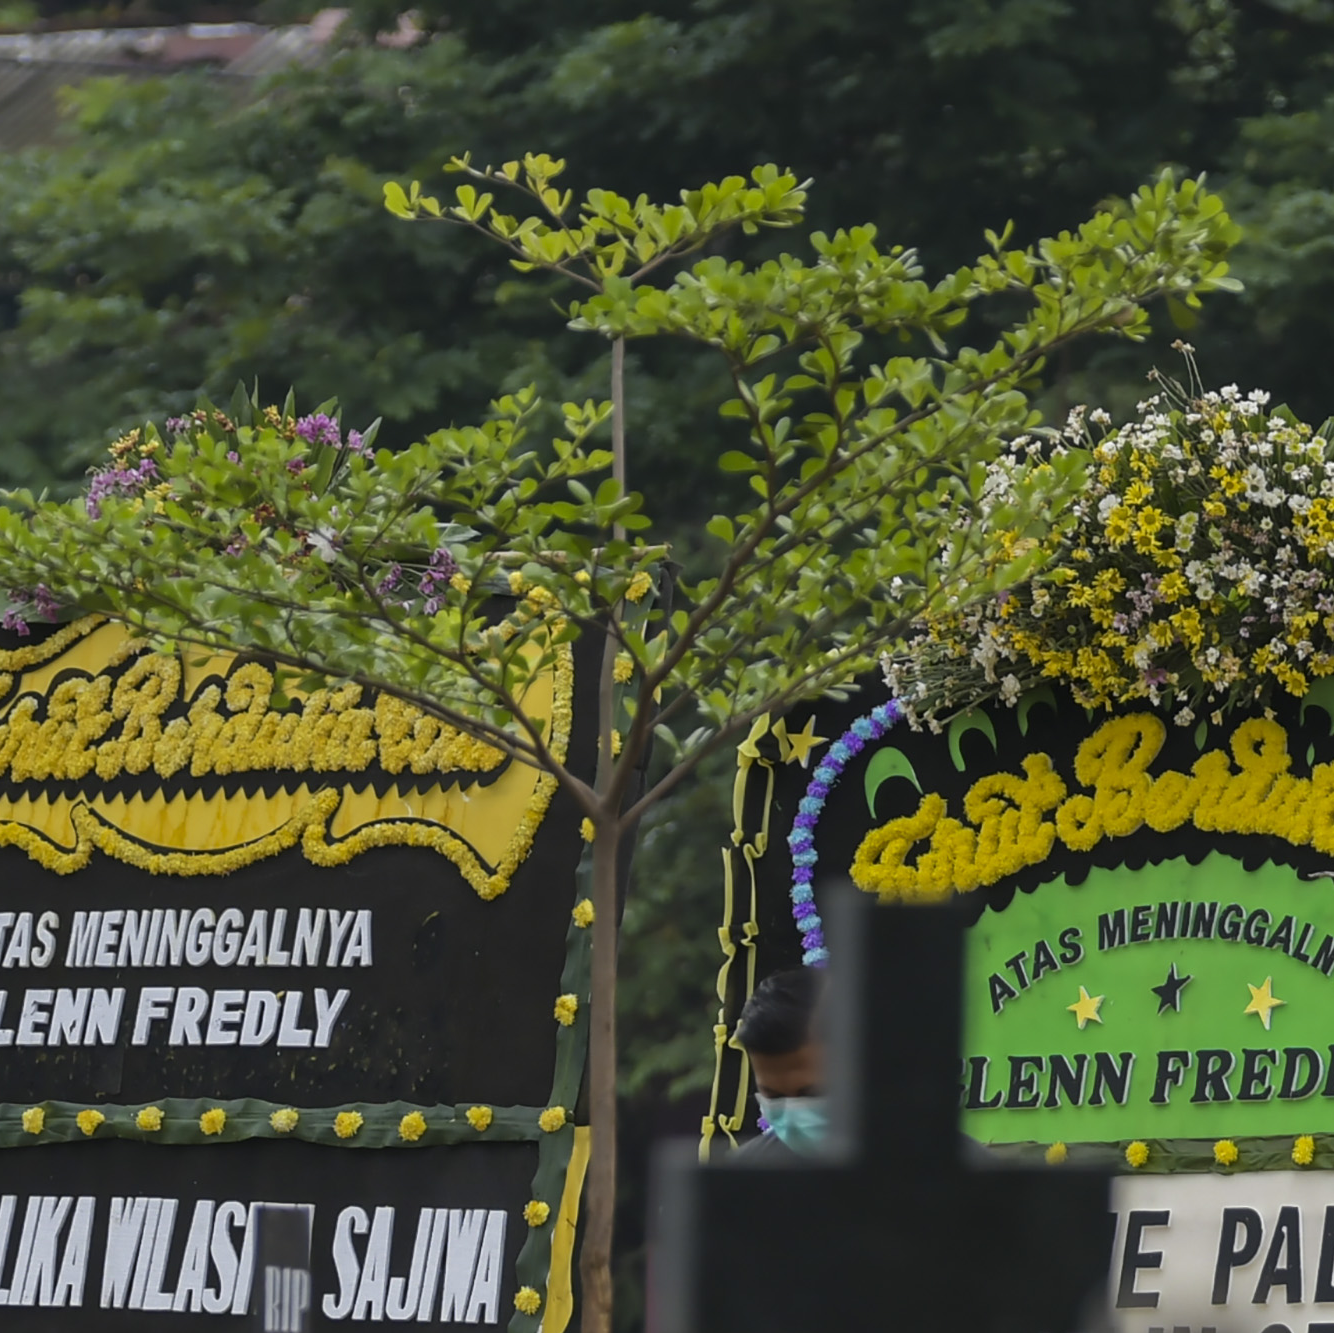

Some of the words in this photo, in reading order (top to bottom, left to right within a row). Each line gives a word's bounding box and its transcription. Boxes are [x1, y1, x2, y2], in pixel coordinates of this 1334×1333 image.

[65, 908, 373, 968] MENINGGALNYA
[987, 926, 1085, 1015] ATAS
[131, 987, 350, 1048] FREDLY
[961, 1051, 1135, 1111] LENN
[321, 1205, 508, 1324] SAJIWA
[264, 1265, 311, 1333] RIP
